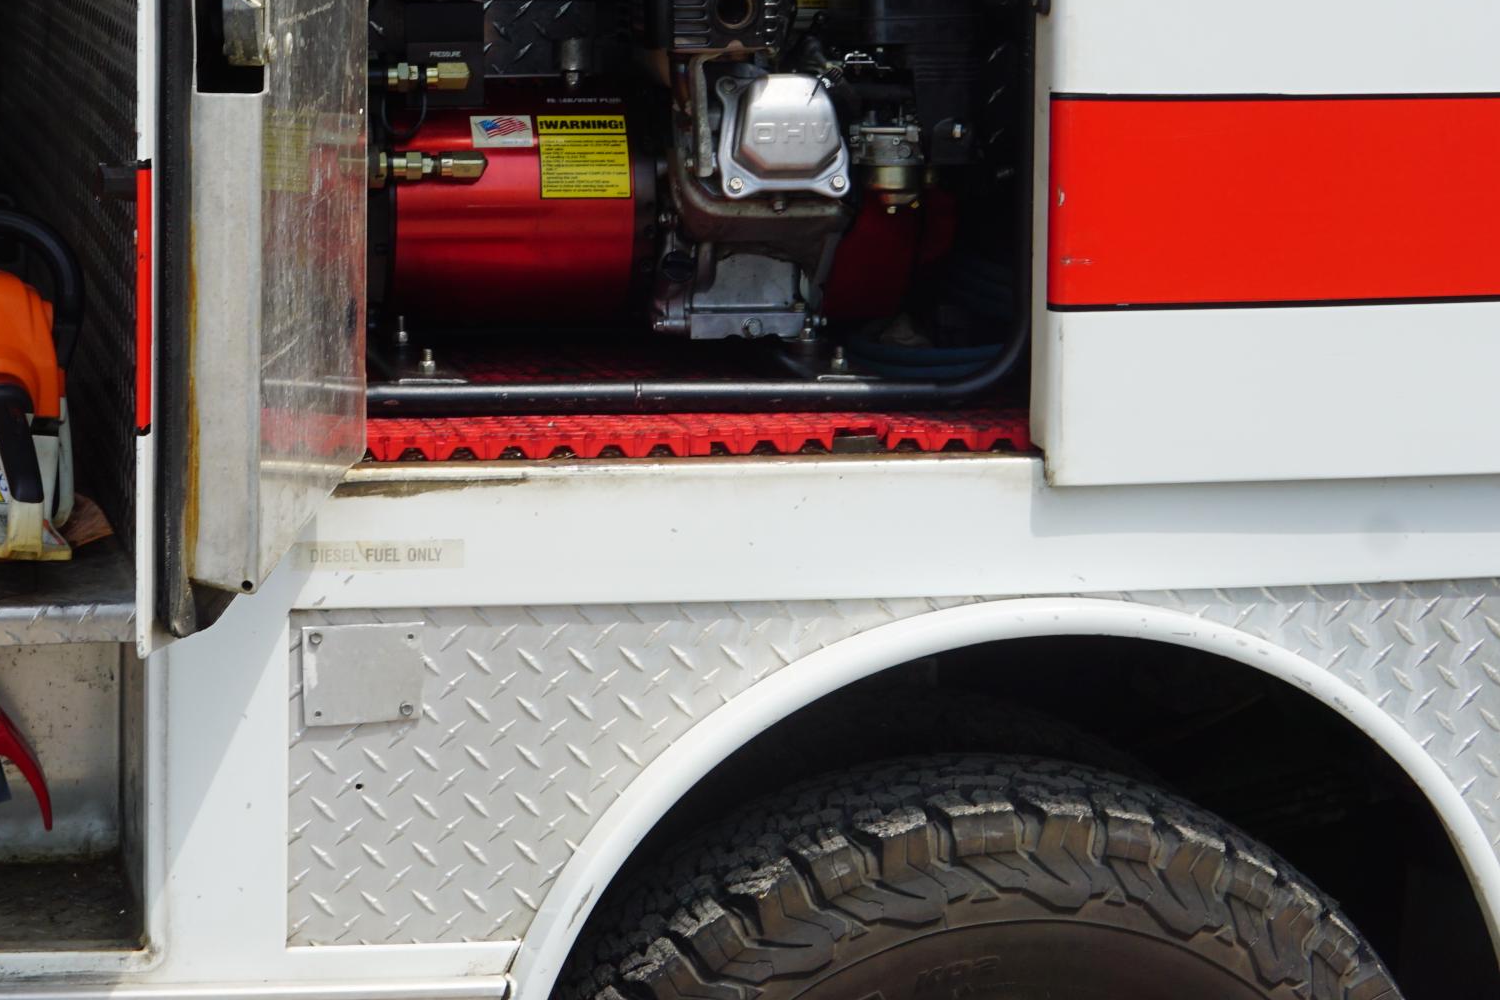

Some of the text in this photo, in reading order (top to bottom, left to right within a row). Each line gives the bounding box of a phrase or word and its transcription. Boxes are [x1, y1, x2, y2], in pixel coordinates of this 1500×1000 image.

[753, 122, 833, 144] OHV
[310, 547, 443, 563] DIESEL FUEL ONLY
